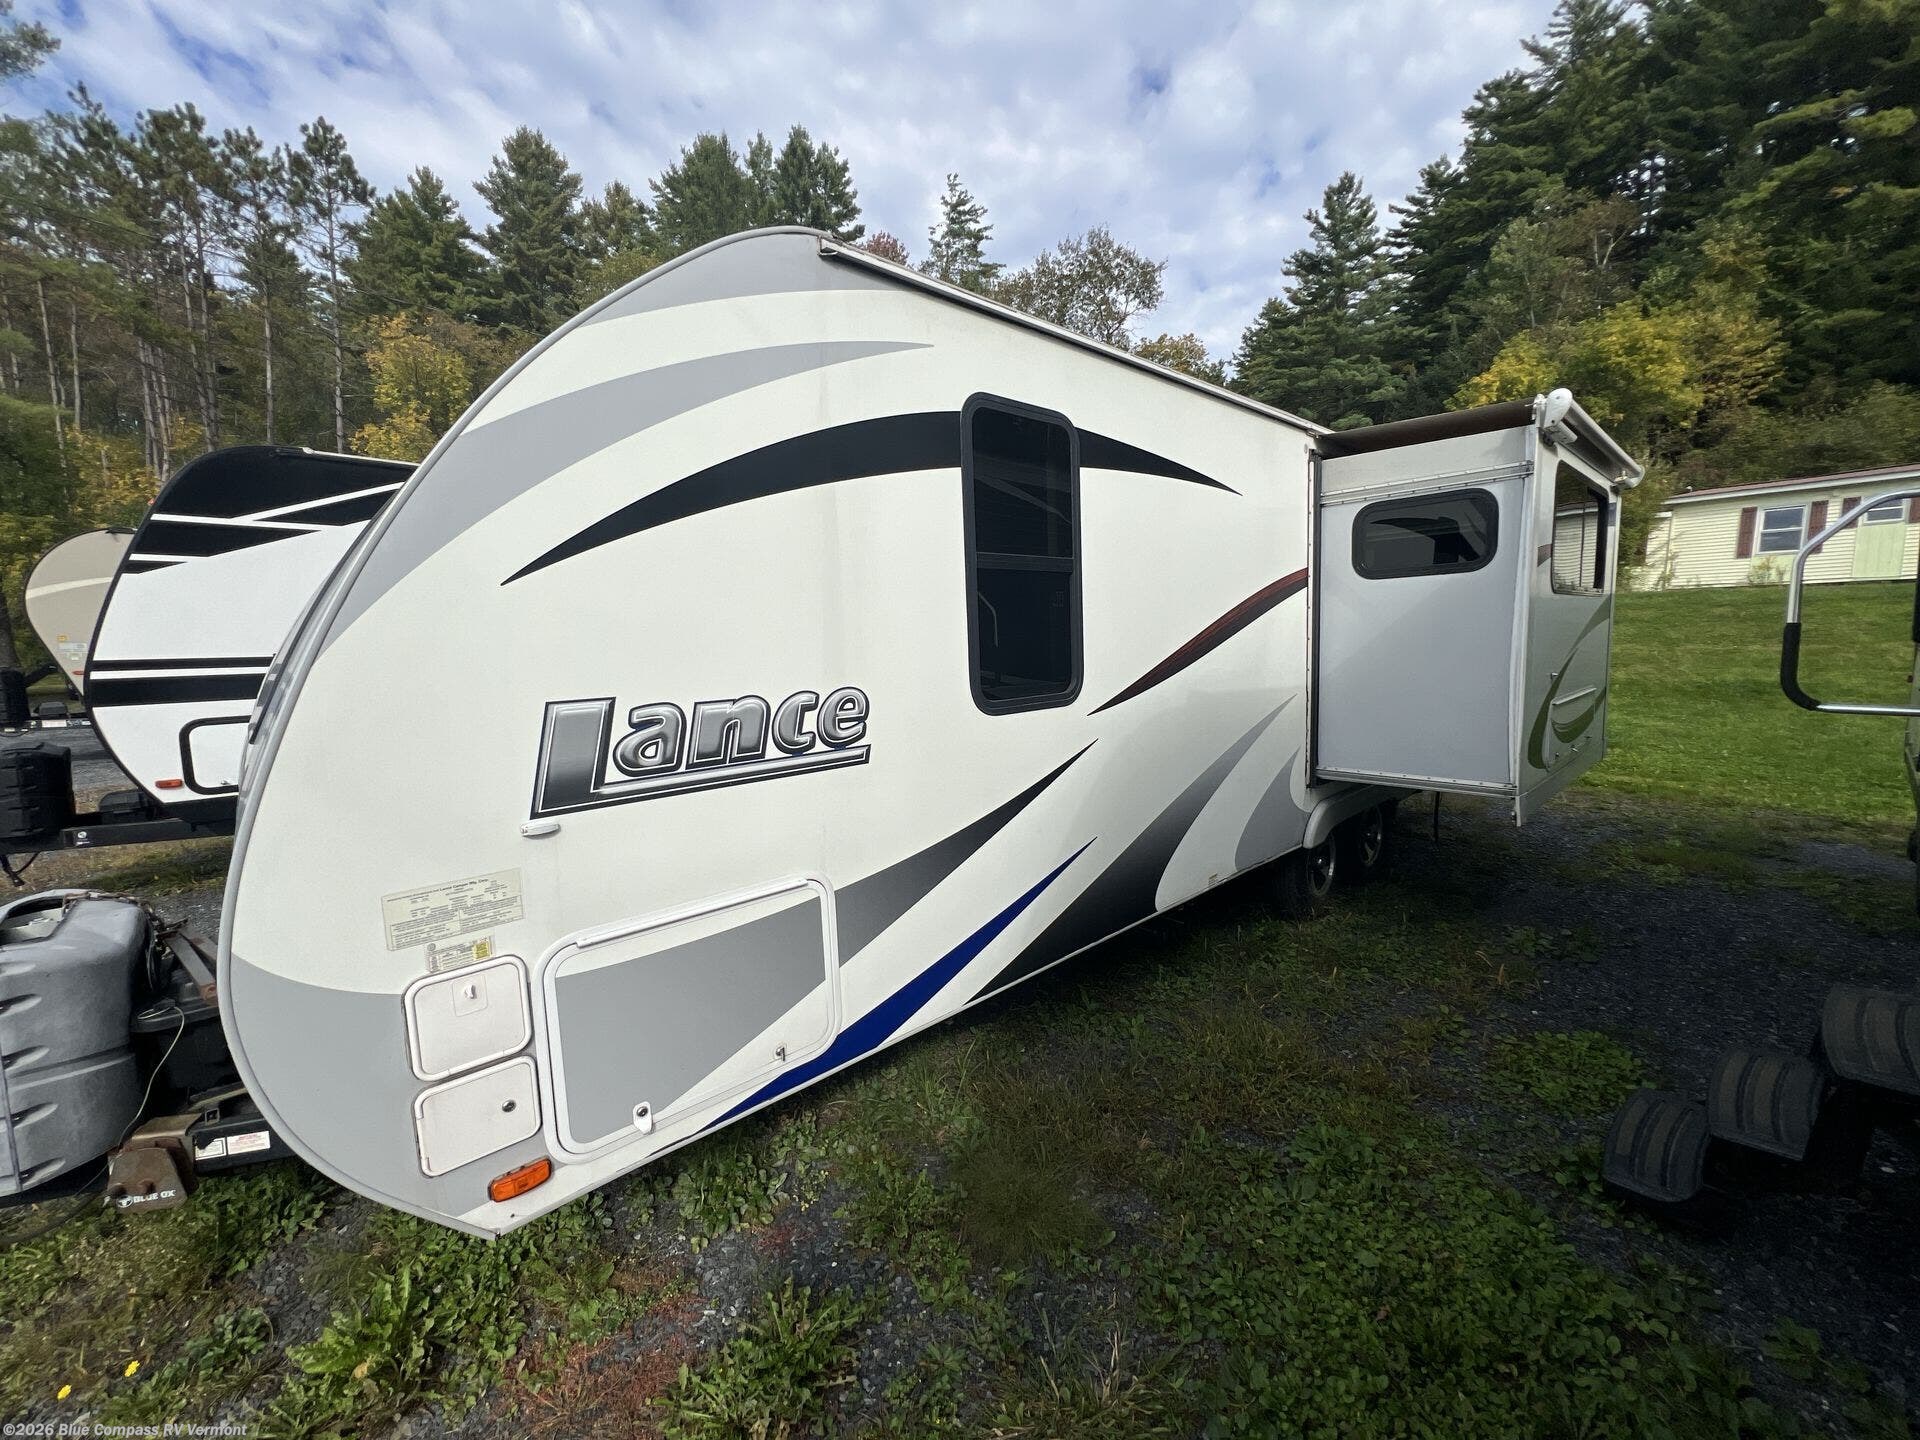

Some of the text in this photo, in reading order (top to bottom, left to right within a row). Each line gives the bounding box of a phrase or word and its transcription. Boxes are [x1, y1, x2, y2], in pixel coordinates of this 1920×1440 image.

[530, 686, 871, 820] Lance
[133, 1189, 176, 1203] BLUE OX
